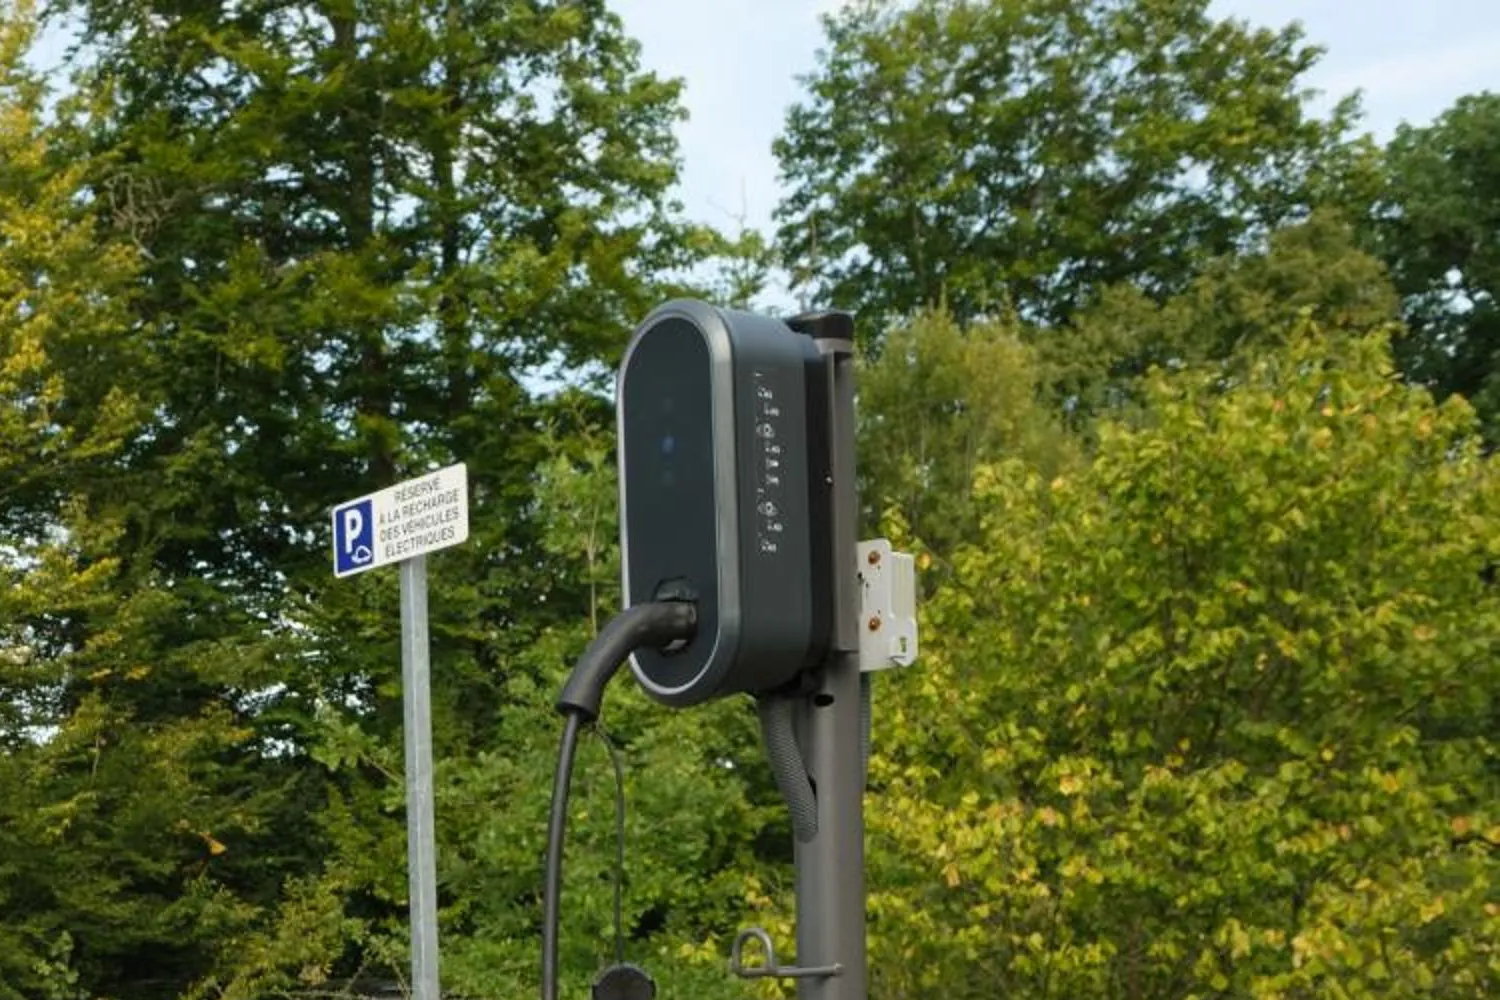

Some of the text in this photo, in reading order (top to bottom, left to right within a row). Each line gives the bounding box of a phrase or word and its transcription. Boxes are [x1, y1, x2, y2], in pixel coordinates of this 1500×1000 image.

[387, 509, 400, 523] LA
[402, 488, 460, 515] RECHARGE
[344, 508, 363, 554] P
[379, 526, 401, 542] DES
